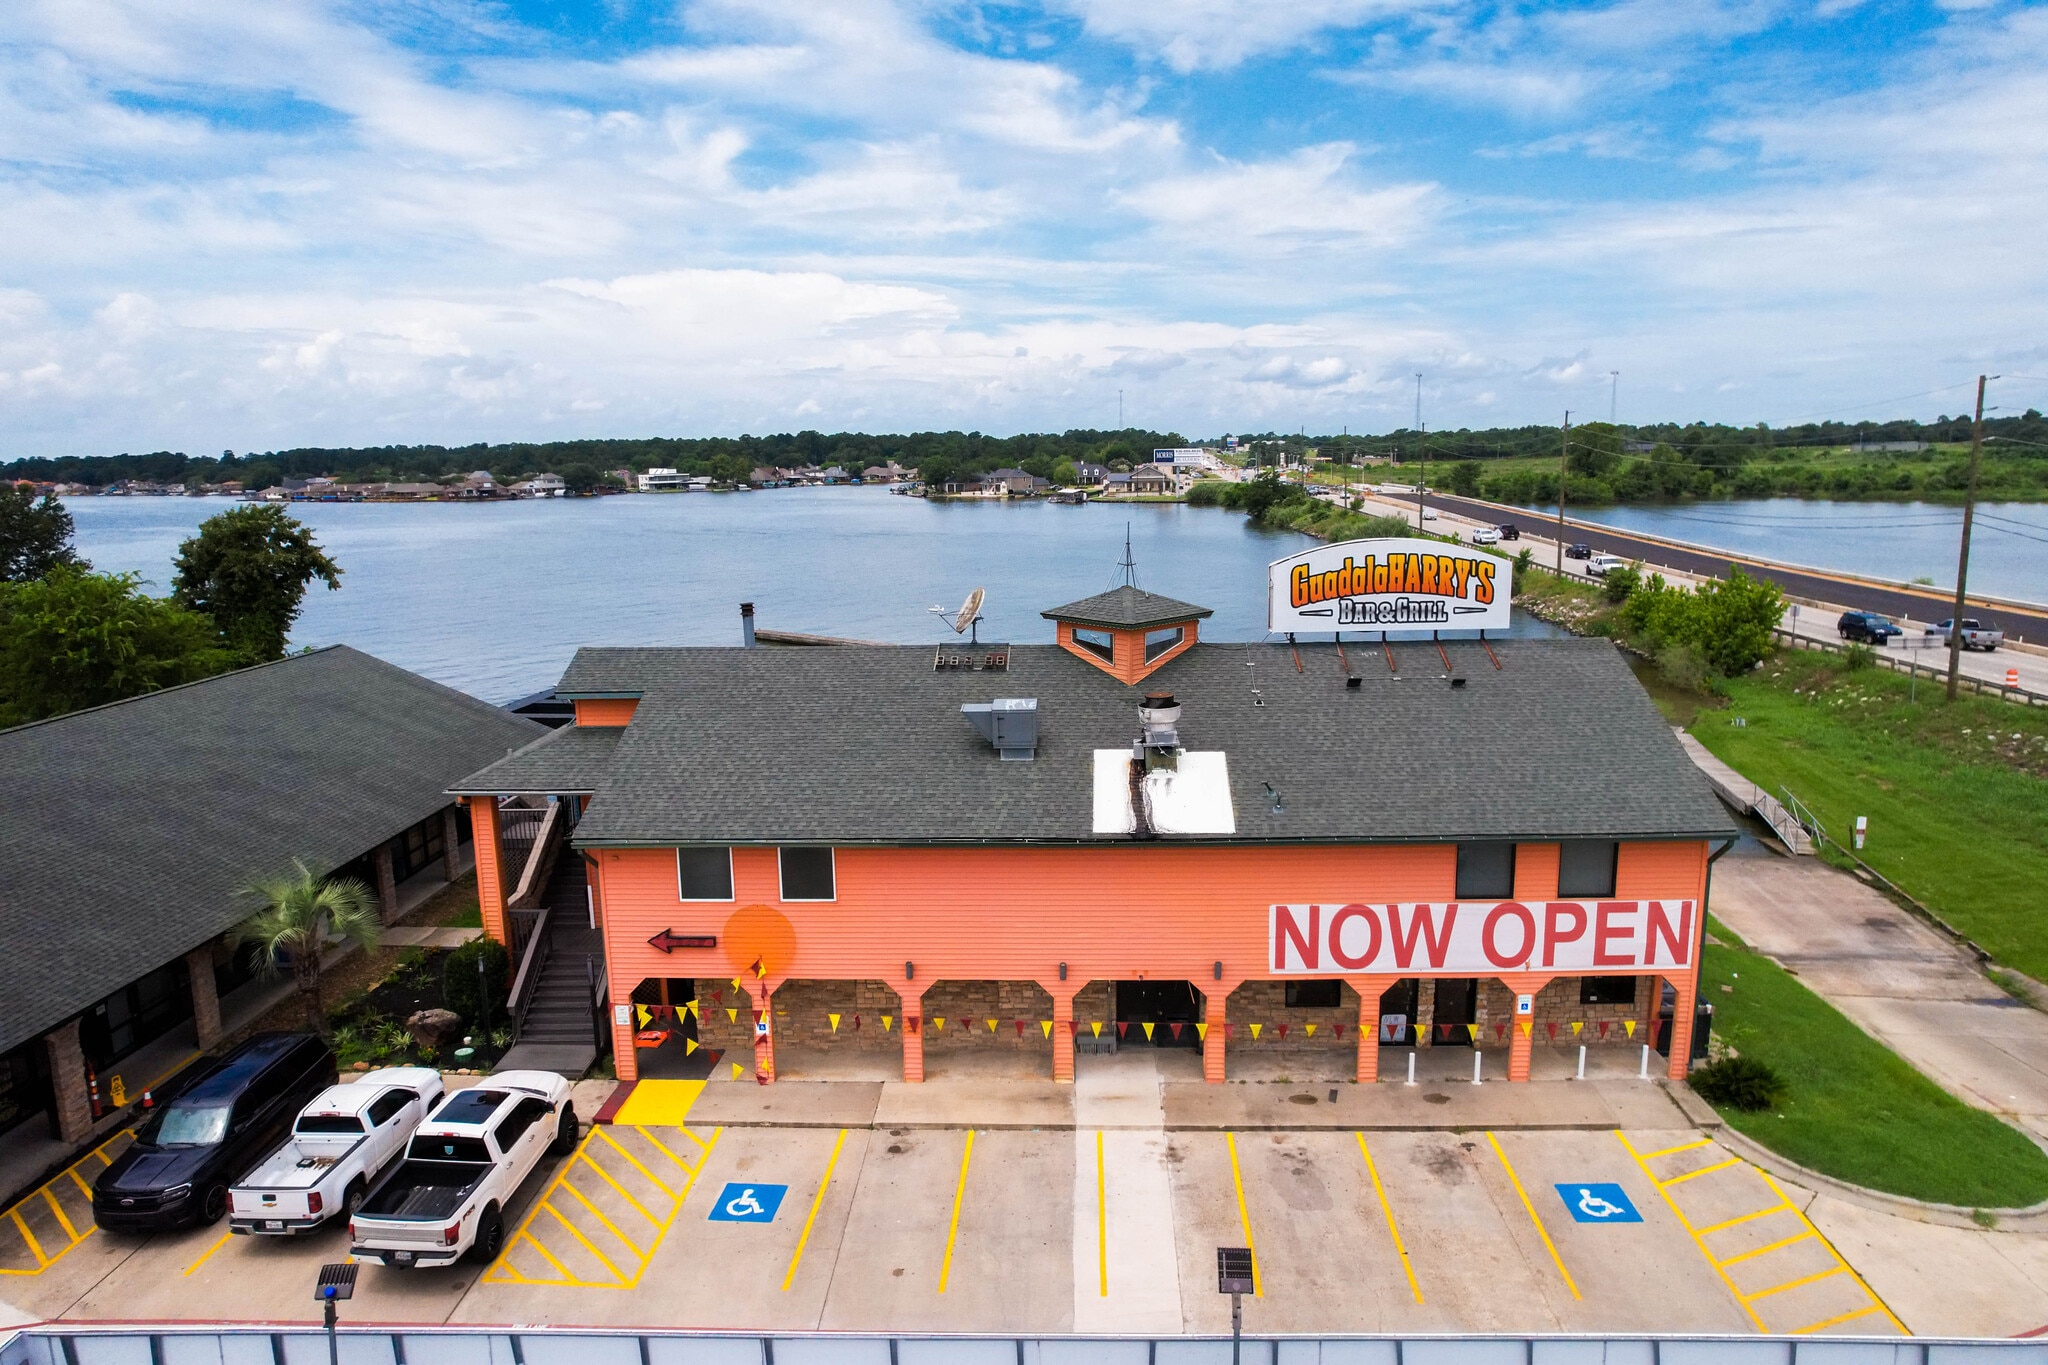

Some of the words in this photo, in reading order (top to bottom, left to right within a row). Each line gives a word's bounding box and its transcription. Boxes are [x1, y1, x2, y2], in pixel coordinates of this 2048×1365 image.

[1290, 553, 1495, 608] GuadalaHARRY'S
[1275, 903, 1459, 970] NOW
[1482, 901, 1692, 967] OPEN
